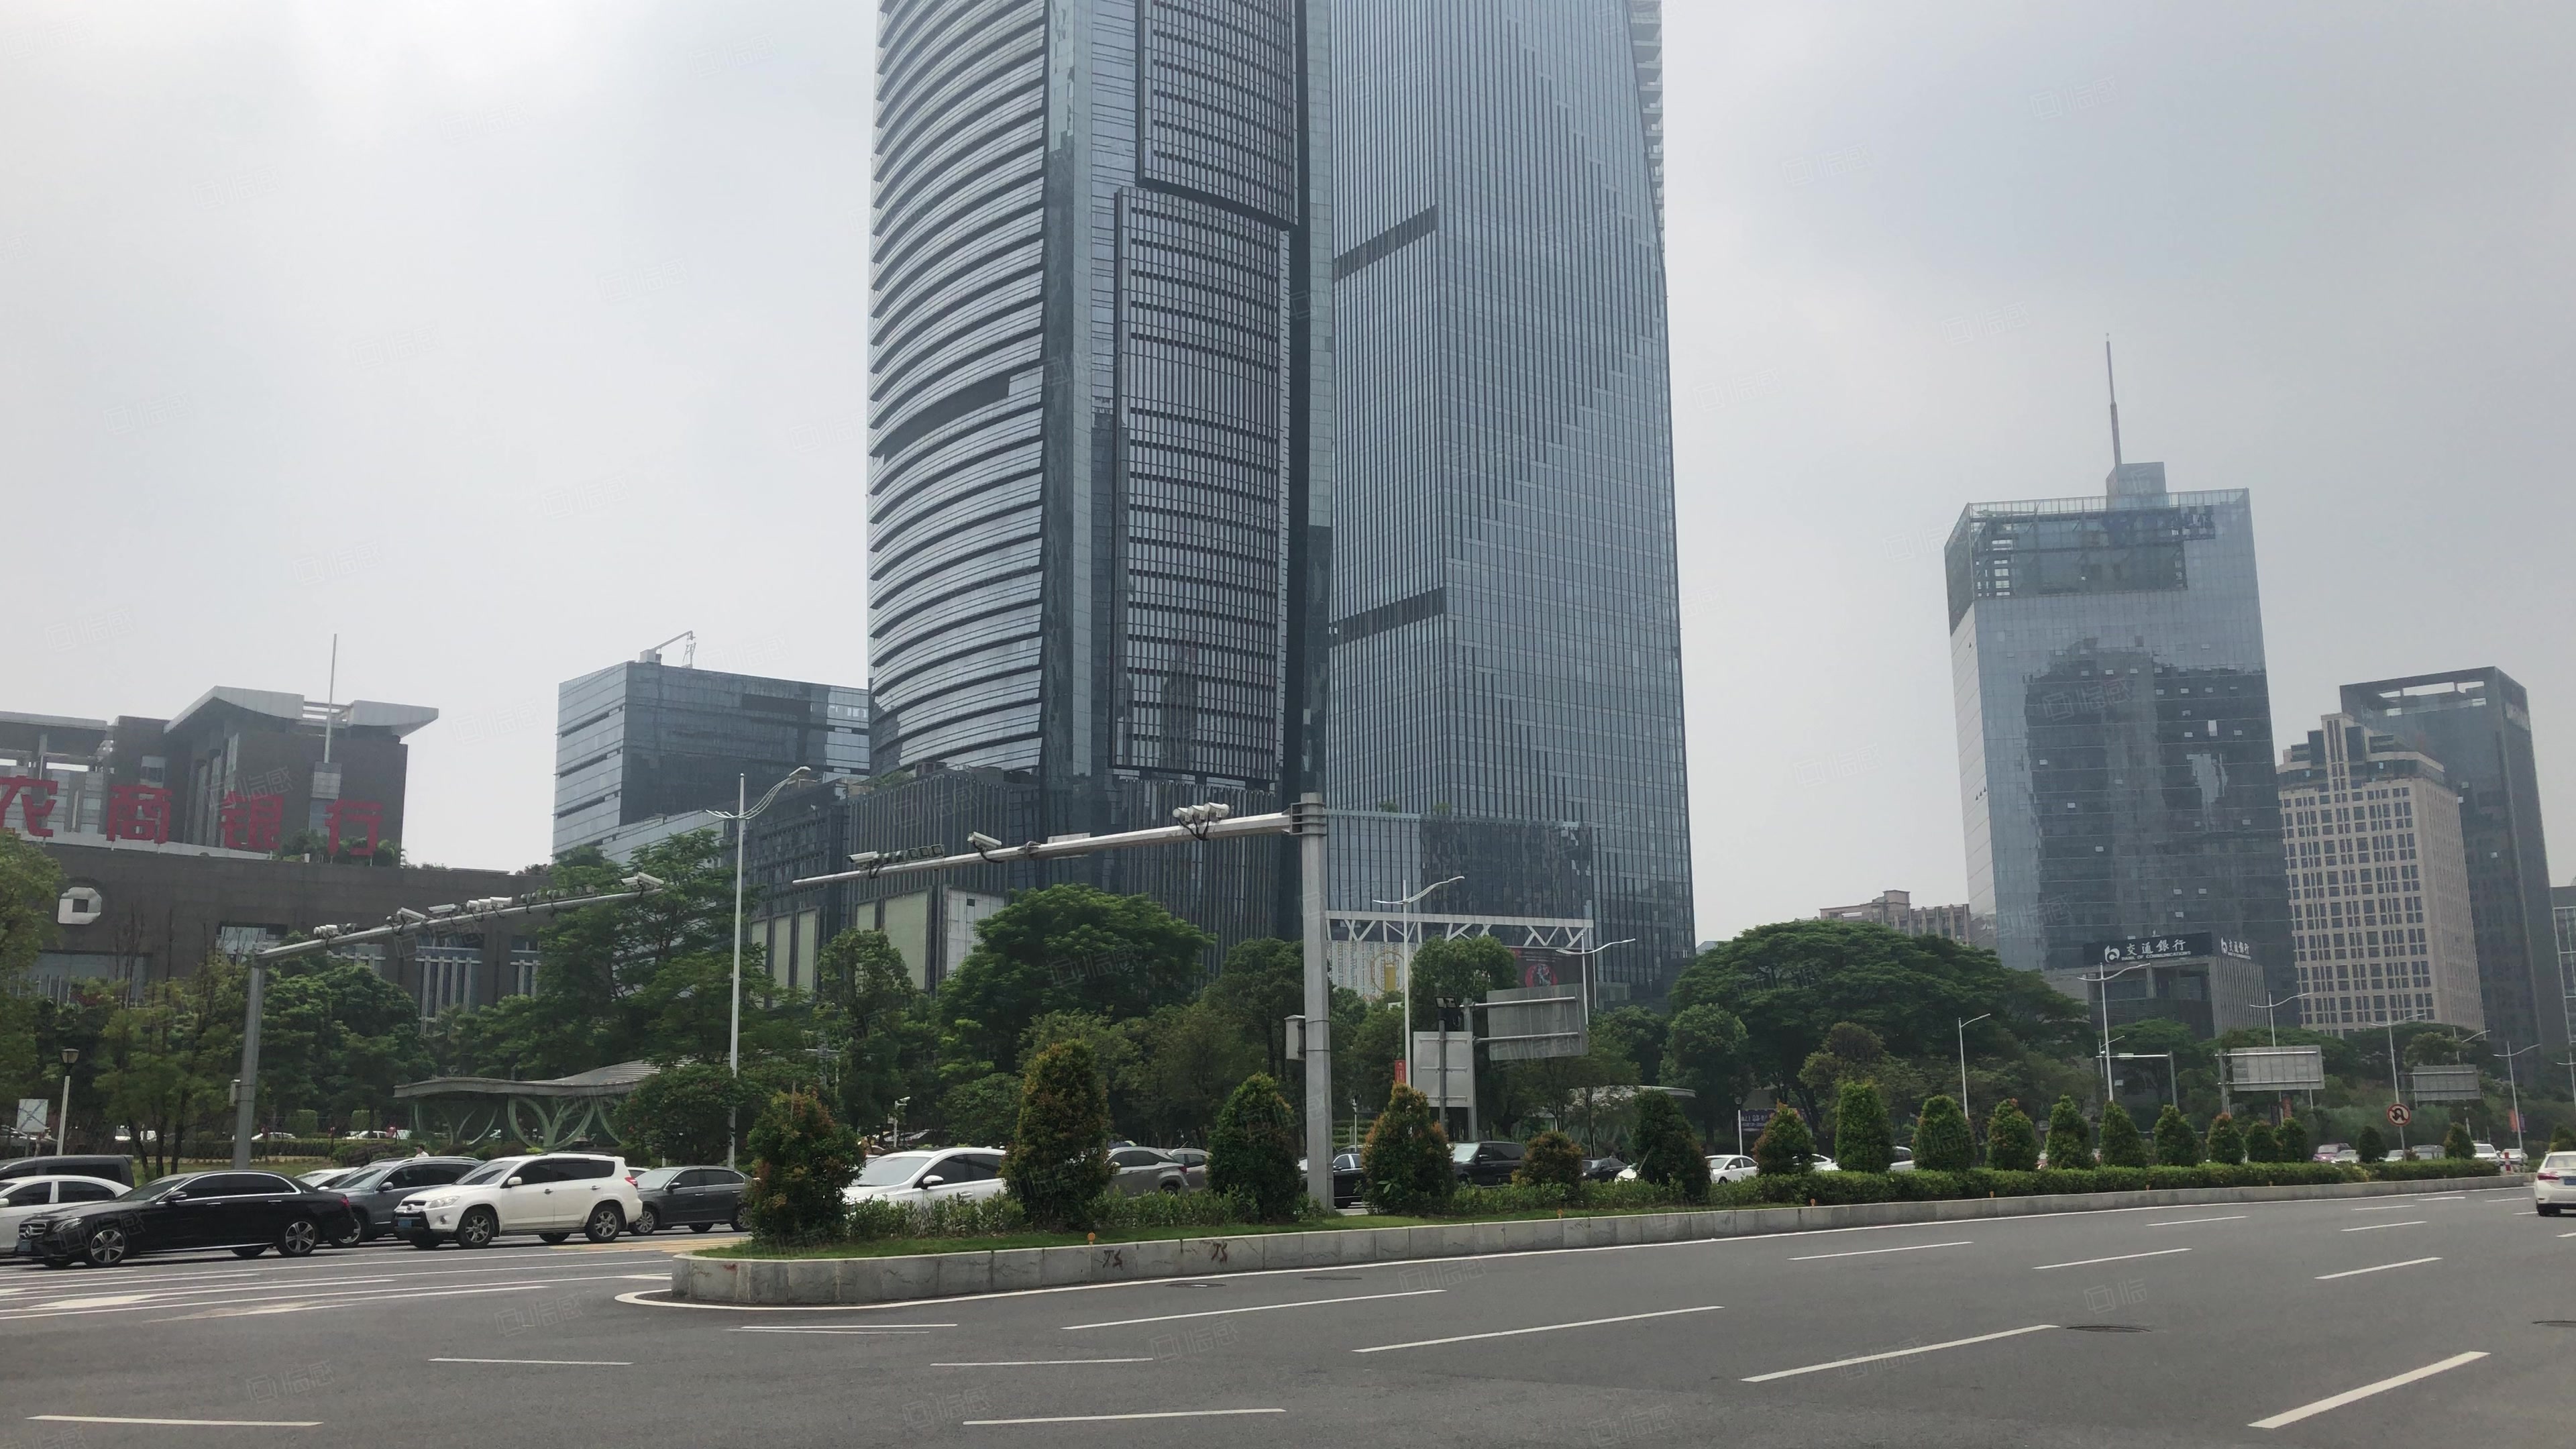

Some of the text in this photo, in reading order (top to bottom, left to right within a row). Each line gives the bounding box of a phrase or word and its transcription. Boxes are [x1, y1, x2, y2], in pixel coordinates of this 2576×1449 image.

[0, 775, 384, 857] 农商银行
[2127, 939, 2186, 956] 交通銀行
